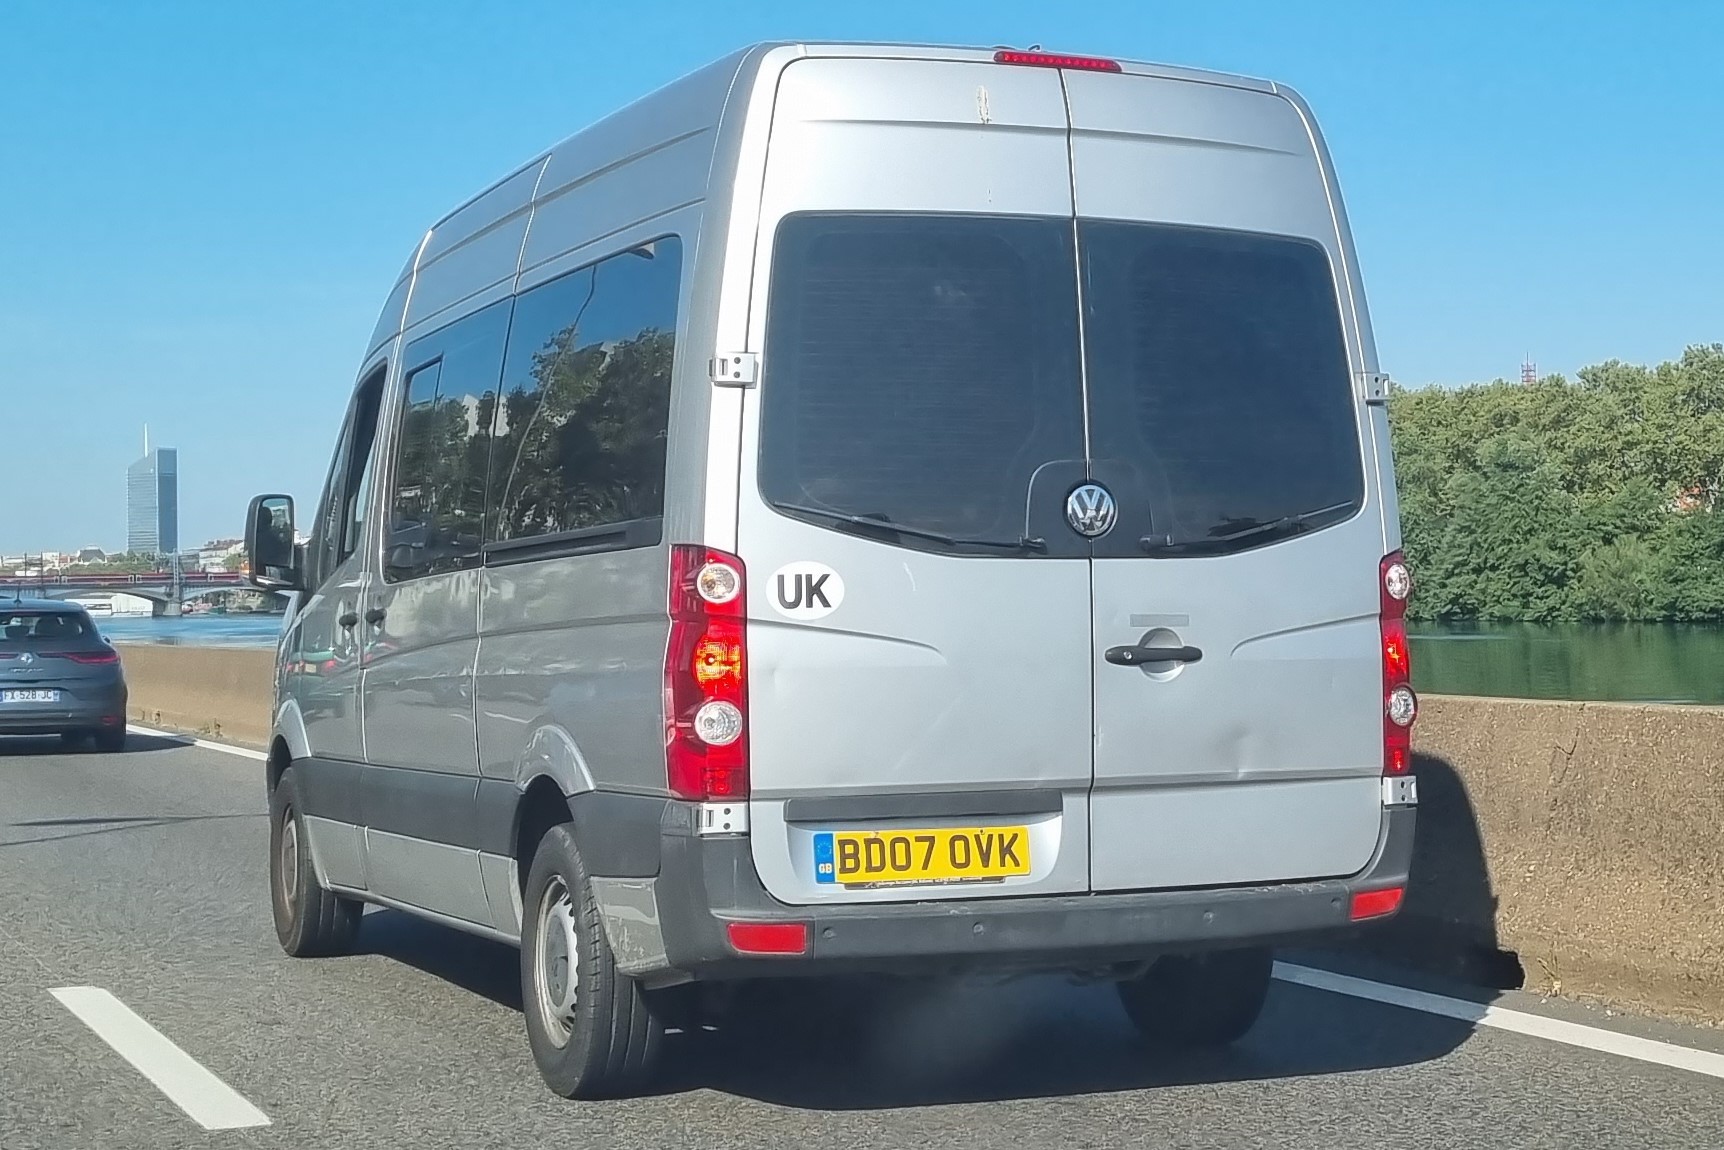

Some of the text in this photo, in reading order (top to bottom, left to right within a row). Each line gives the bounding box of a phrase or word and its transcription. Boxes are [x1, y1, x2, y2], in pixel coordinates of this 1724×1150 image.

[777, 573, 832, 609] UK
[838, 833, 1020, 874] BD07 OVK
